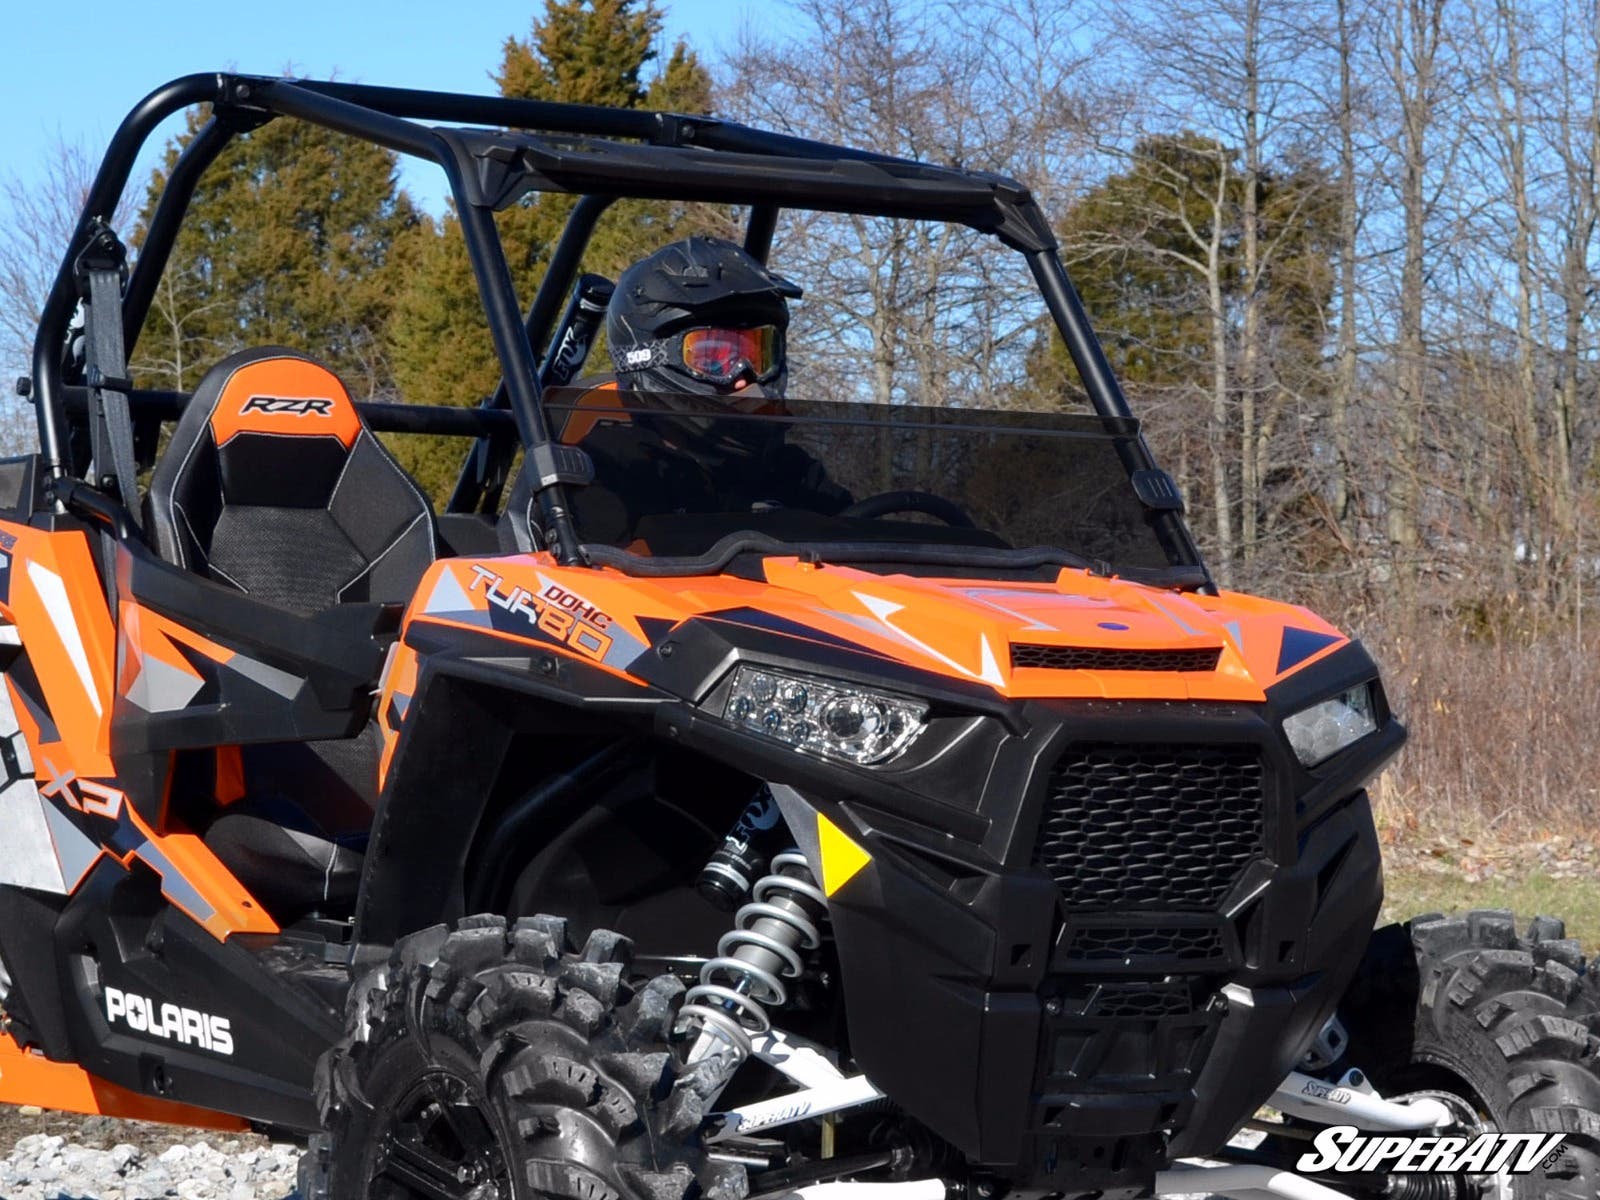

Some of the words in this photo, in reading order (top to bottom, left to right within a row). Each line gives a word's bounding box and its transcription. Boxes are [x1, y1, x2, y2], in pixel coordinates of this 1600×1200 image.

[626, 348, 651, 364] 509
[239, 394, 335, 418] RZR
[469, 563, 613, 663] TURBO
[544, 585, 613, 629] DOHC
[40, 757, 124, 820] XP
[104, 986, 234, 1055] POLARIS
